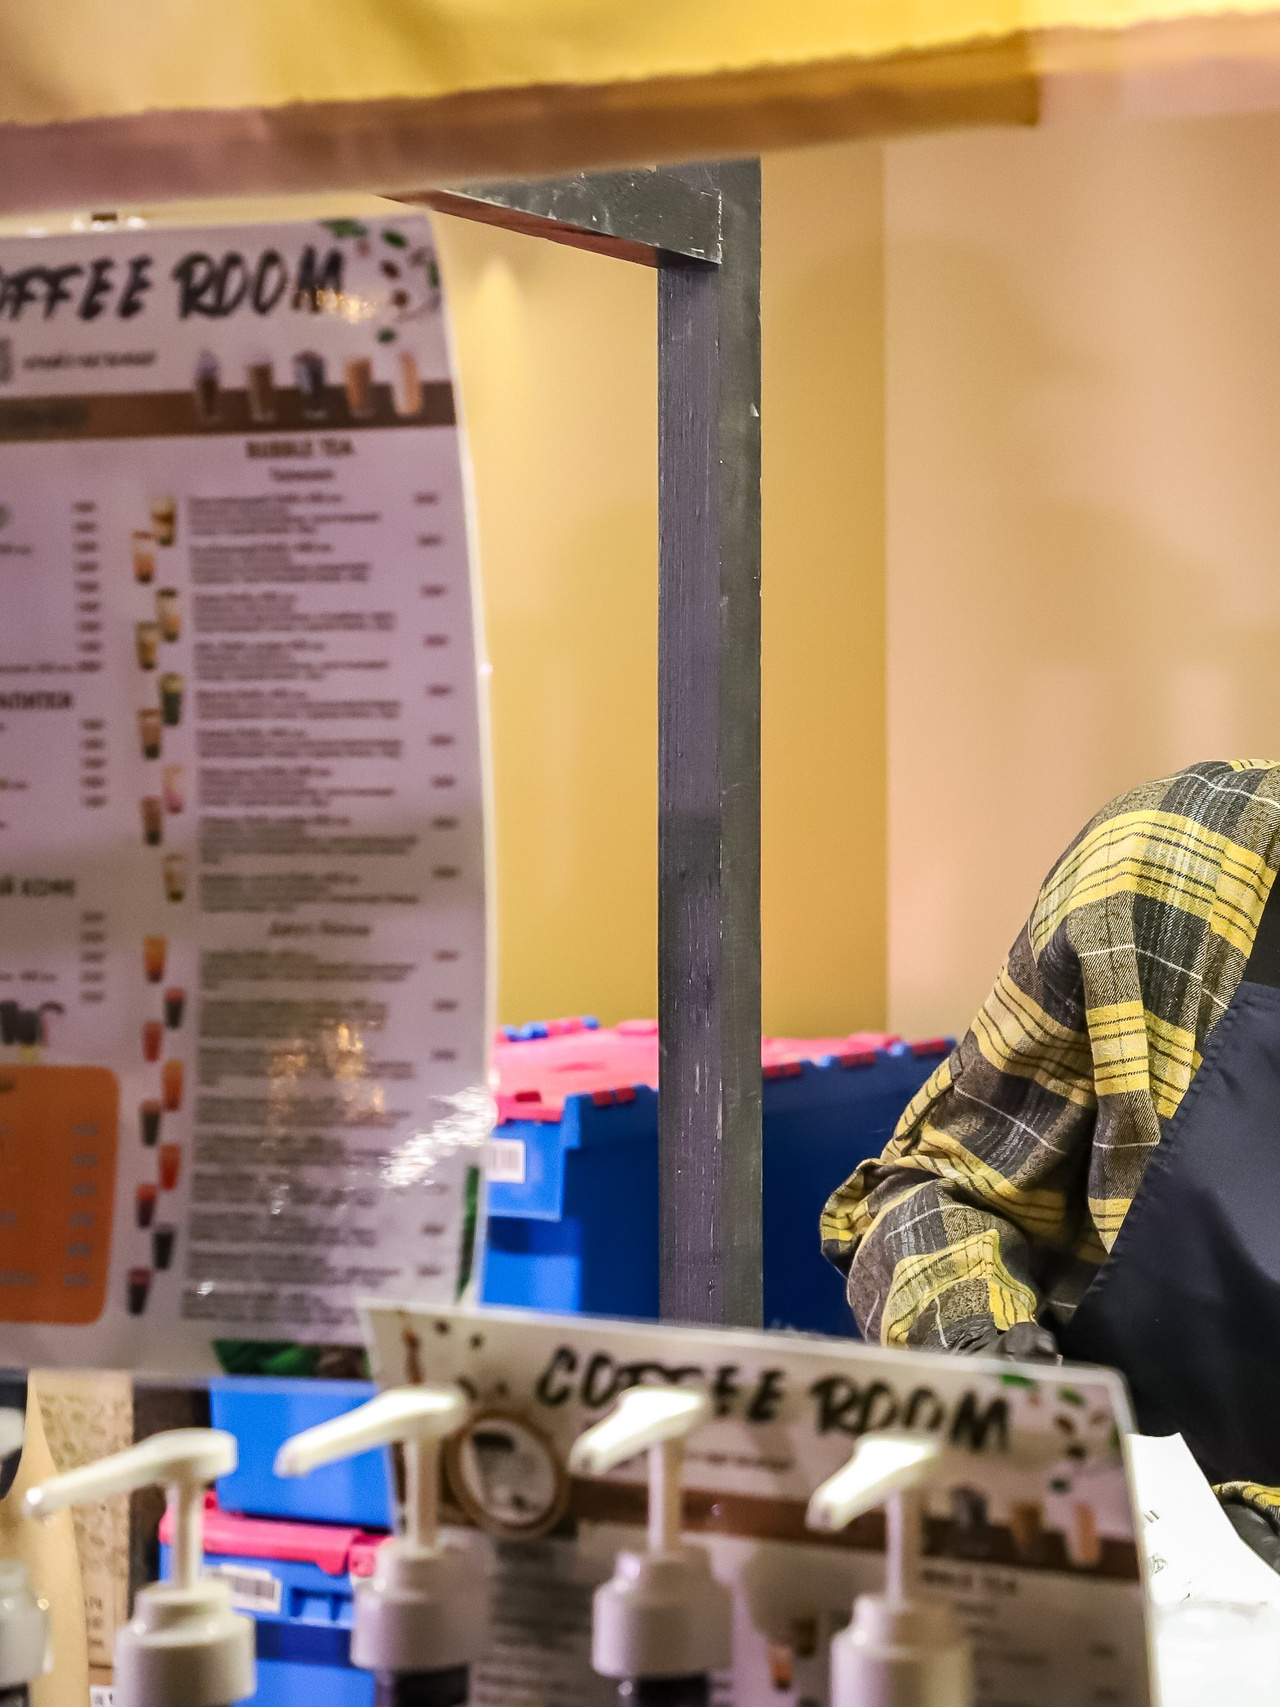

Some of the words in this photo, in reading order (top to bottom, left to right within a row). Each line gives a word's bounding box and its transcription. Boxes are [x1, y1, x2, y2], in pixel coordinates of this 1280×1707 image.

[0, 252, 152, 322] FFEE
[173, 246, 344, 319] ROOM
[811, 1373, 1010, 1452] ROOM
